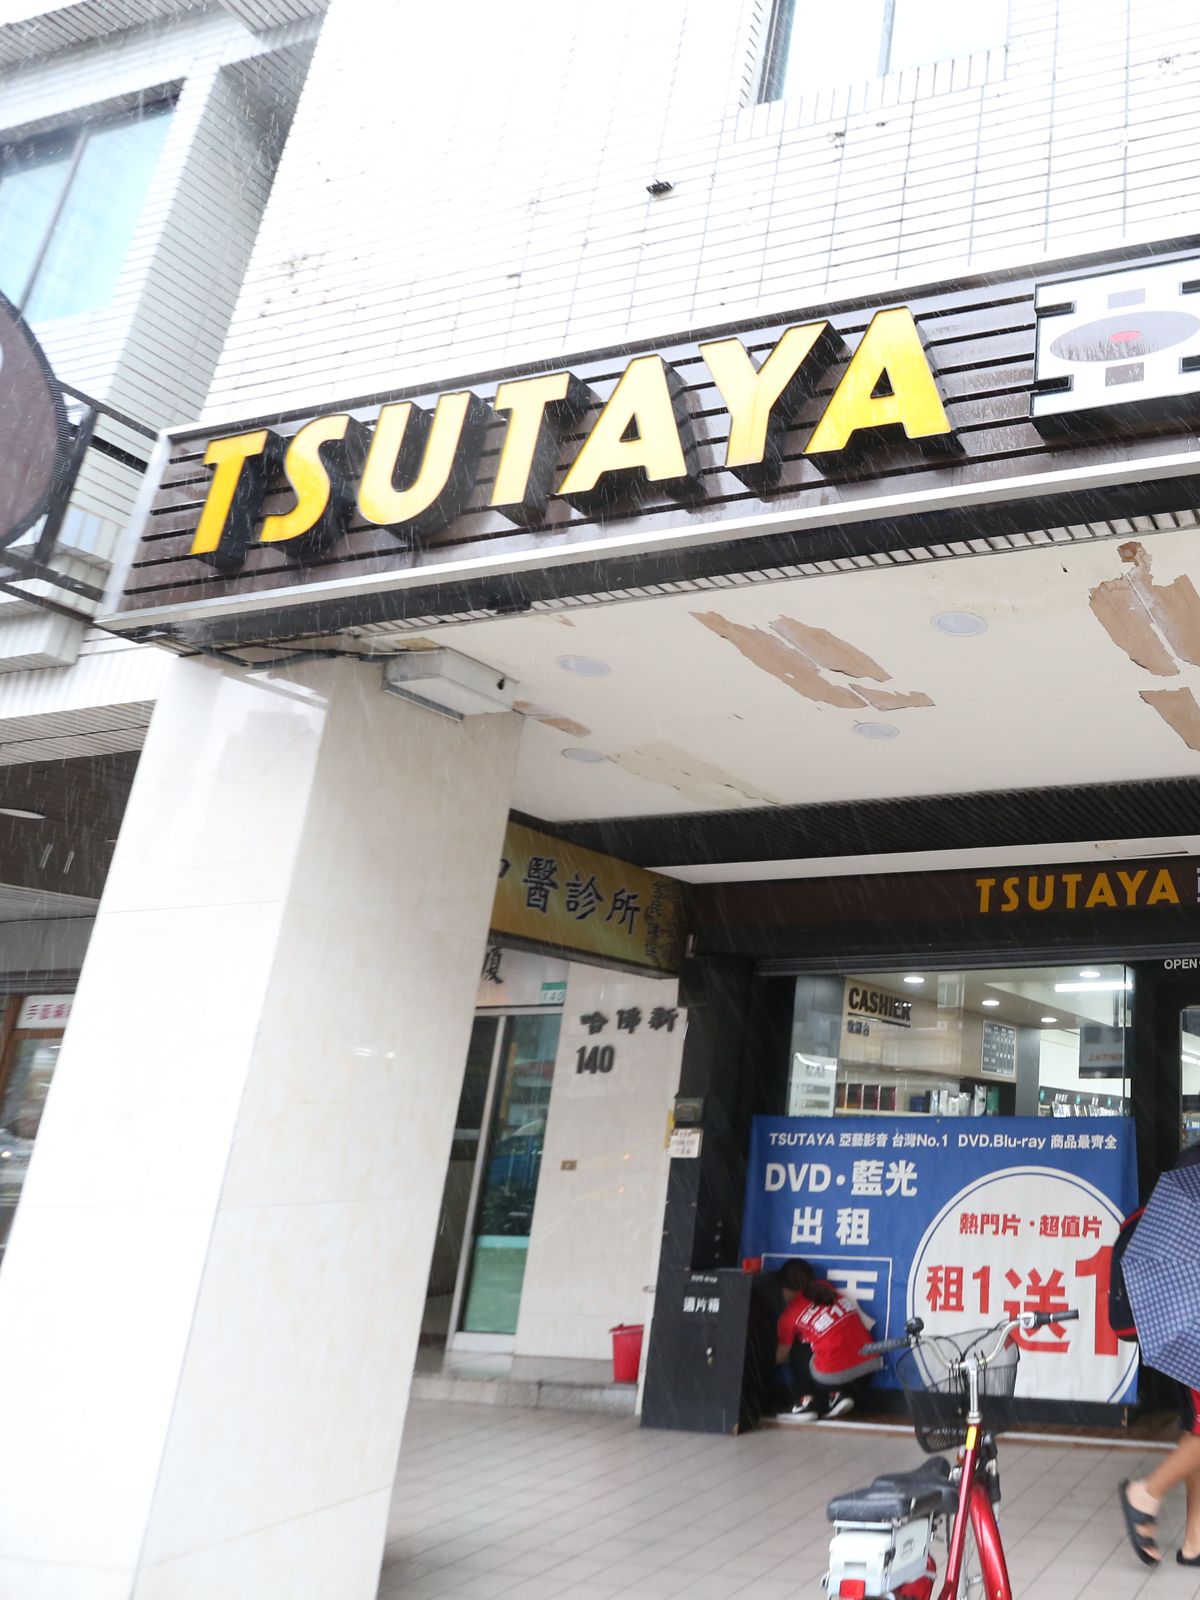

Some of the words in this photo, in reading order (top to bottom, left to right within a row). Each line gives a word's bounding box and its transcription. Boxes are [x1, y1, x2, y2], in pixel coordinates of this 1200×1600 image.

[191, 306, 953, 555] TSUTAYA
[498, 857, 641, 936] 醫診所
[976, 868, 1181, 914] TSUTAYA
[1164, 958, 1198, 970] OPEN
[848, 986, 912, 1021] CASHIER
[576, 1045, 615, 1075] 140
[769, 1132, 835, 1147] TSUTAYA
[838, 1132, 888, 1148] 亞藝影音
[1050, 1134, 1118, 1150] 商品最齊全
